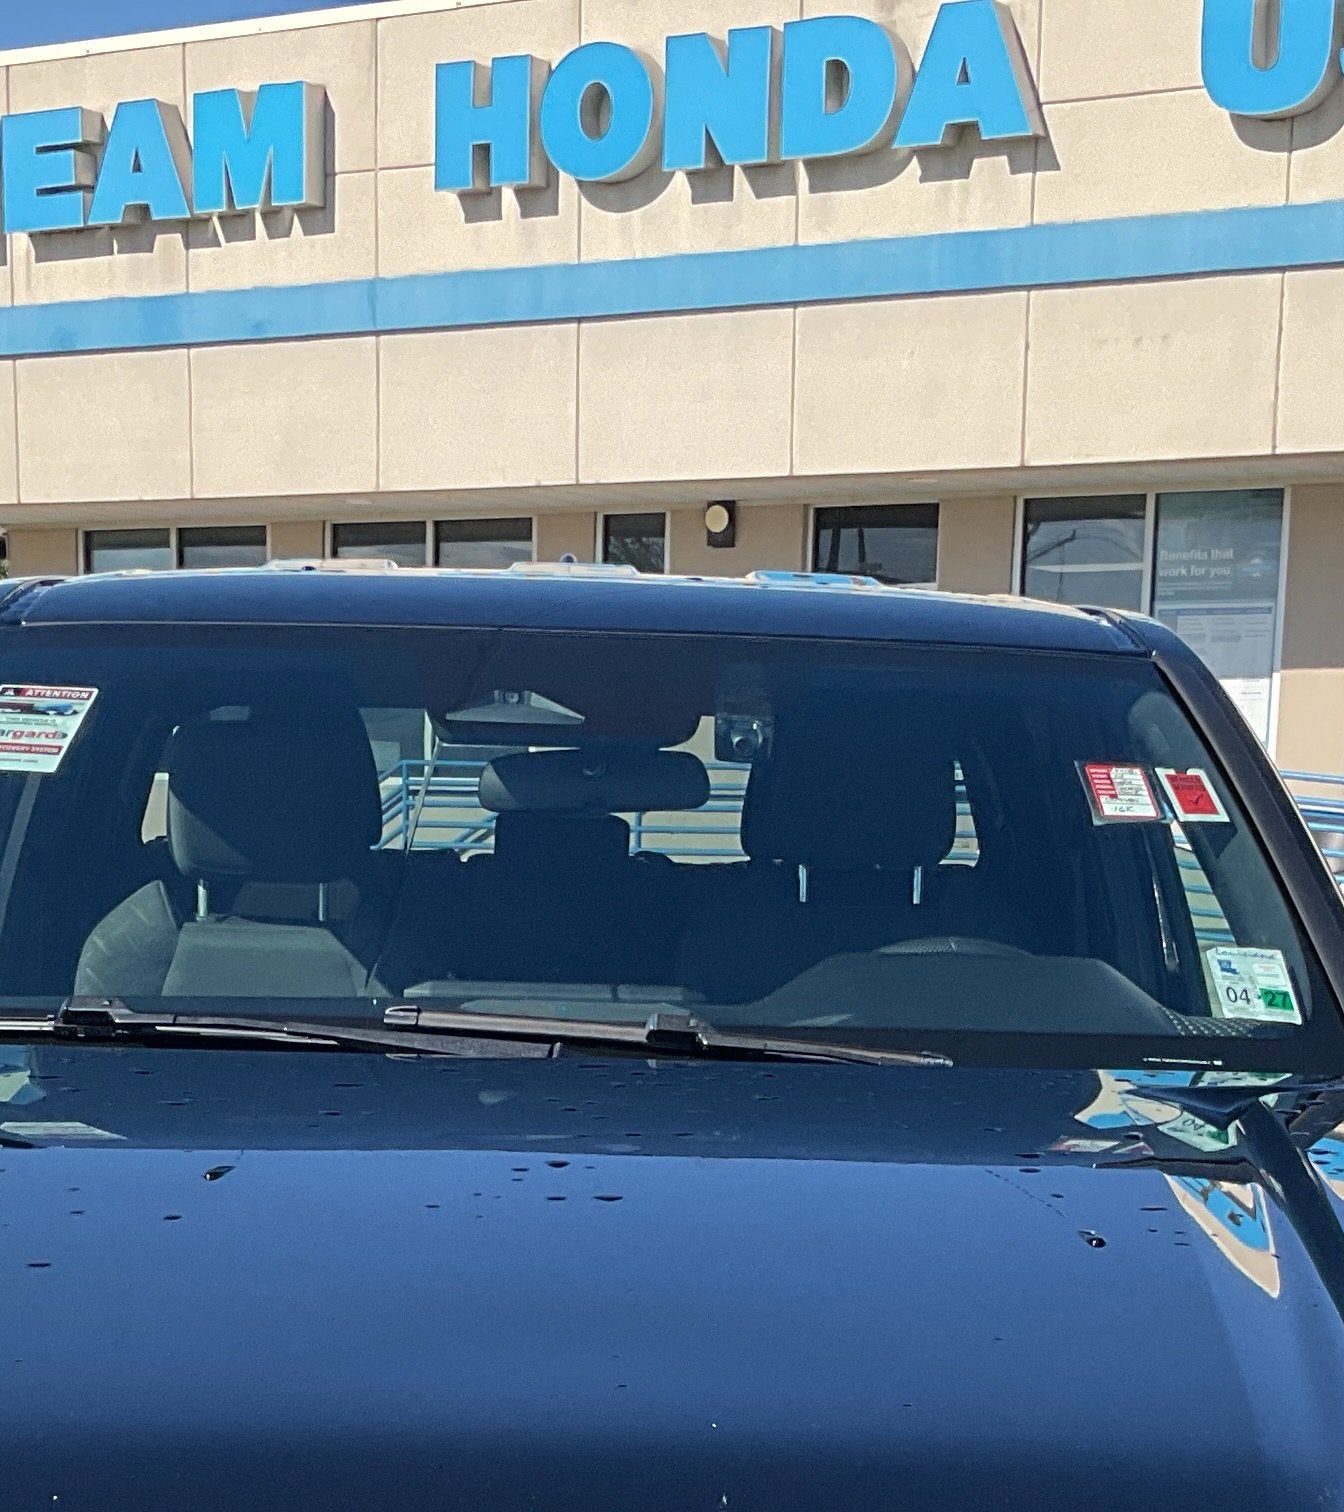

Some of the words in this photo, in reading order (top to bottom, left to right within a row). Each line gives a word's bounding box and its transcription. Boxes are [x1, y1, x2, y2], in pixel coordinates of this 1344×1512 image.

[435, 0, 1041, 190] HONDA
[1159, 550, 1208, 561] Benefits
[1210, 548, 1234, 560] that
[1158, 566, 1188, 577] work
[1190, 565, 1207, 577] for
[25, 688, 90, 700] ATTENTION
[1215, 947, 1276, 959] Louisiana
[1226, 986, 1251, 1005] 04
[1264, 991, 1290, 1008] 27
